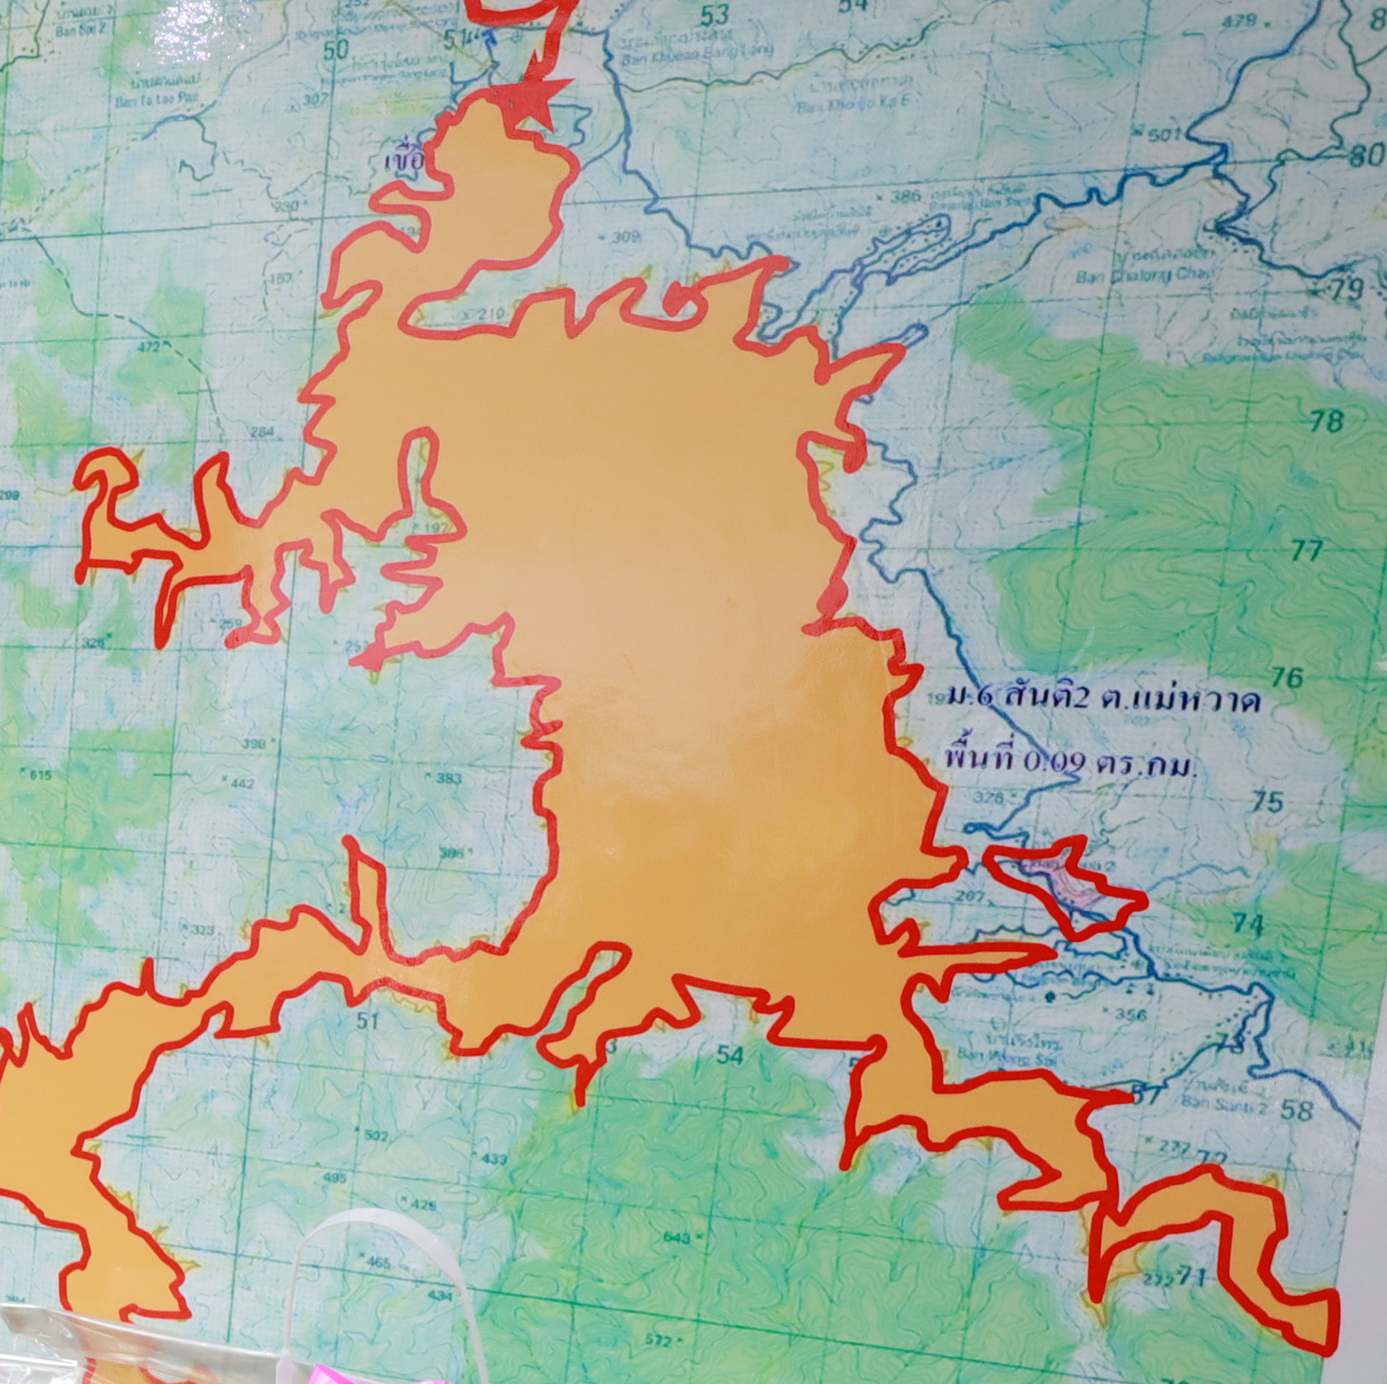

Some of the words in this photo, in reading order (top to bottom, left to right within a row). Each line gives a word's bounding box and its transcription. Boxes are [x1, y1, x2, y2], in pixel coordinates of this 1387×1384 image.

[701, 4, 729, 27] 53
[56, 25, 77, 36] Ban
[323, 39, 349, 60] 50
[1349, 142, 1386, 168] 80
[891, 190, 921, 203] 386
[1331, 277, 1364, 301] 79
[137, 341, 160, 353] 472
[1308, 409, 1345, 433] 78
[1291, 540, 1323, 561] 77
[1271, 666, 1303, 689] 76
[948, 684, 993, 706] ม.6
[1005, 678, 1090, 709] สันติ2
[1102, 681, 1262, 713] ต.แม่หวาด
[946, 728, 1015, 771] พื้นที่
[1024, 750, 1086, 772] 0.09
[1097, 753, 1198, 778] ตร.กม.
[1252, 790, 1283, 813] 75
[1233, 913, 1264, 936] 74
[357, 1013, 379, 1030] 51
[1115, 1008, 1147, 1021] 356
[717, 1045, 744, 1066] 54
[1181, 1096, 1208, 1109] Ban
[1280, 1099, 1314, 1122] 58
[481, 1152, 508, 1166] 433
[1177, 1264, 1207, 1288] 71
